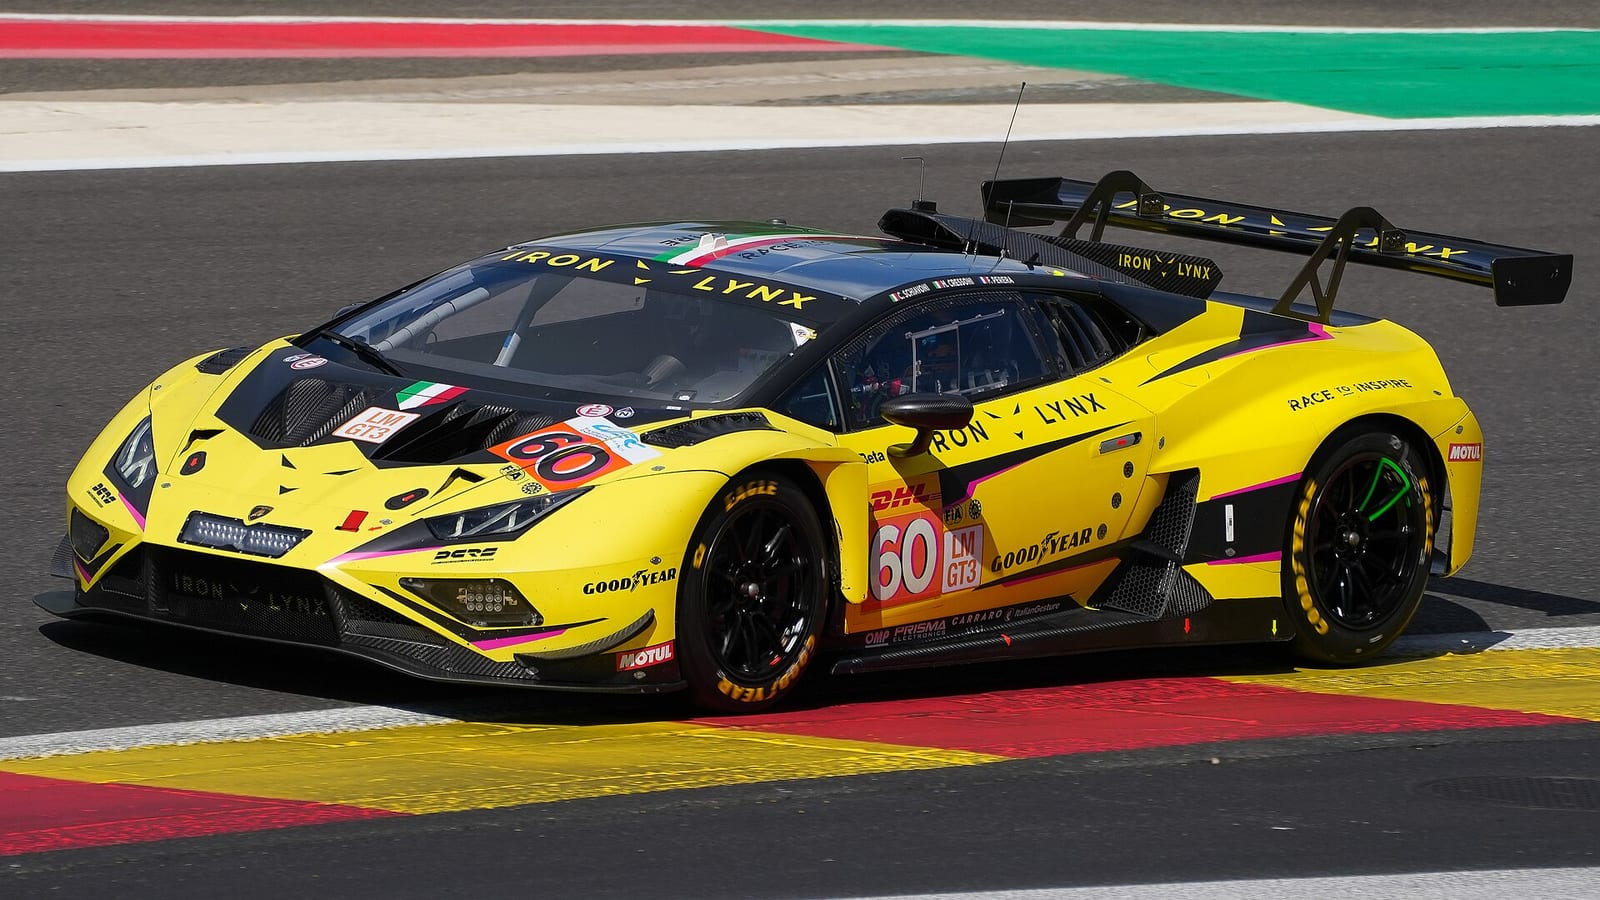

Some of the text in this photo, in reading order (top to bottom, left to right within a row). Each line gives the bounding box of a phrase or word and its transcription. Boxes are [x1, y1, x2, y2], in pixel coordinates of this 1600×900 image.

[1114, 199, 1246, 225] ION
[502, 250, 817, 310] IRON LYNX
[1118, 253, 1210, 280] IRON LYNX
[1287, 379, 1413, 412] RACE TO INSPIRE
[345, 423, 391, 441] GT3
[366, 411, 412, 427] LM
[933, 392, 1107, 453] RON LYNX
[505, 430, 613, 484] 60
[1449, 444, 1481, 460] MOTUL
[502, 464, 522, 481] FIA
[725, 480, 778, 512] EAGLE
[870, 483, 929, 512] DHL
[945, 507, 962, 522] FIA
[951, 531, 975, 560] LM
[870, 517, 938, 602] 60
[947, 558, 977, 588] GT3
[174, 572, 326, 616] IRON LYNX
[894, 619, 947, 637] PRISMA
[951, 609, 1003, 626] CARRARO
[865, 630, 889, 645] OMP
[892, 630, 947, 643] ELECTRONICS
[619, 644, 674, 671] MOTUL
